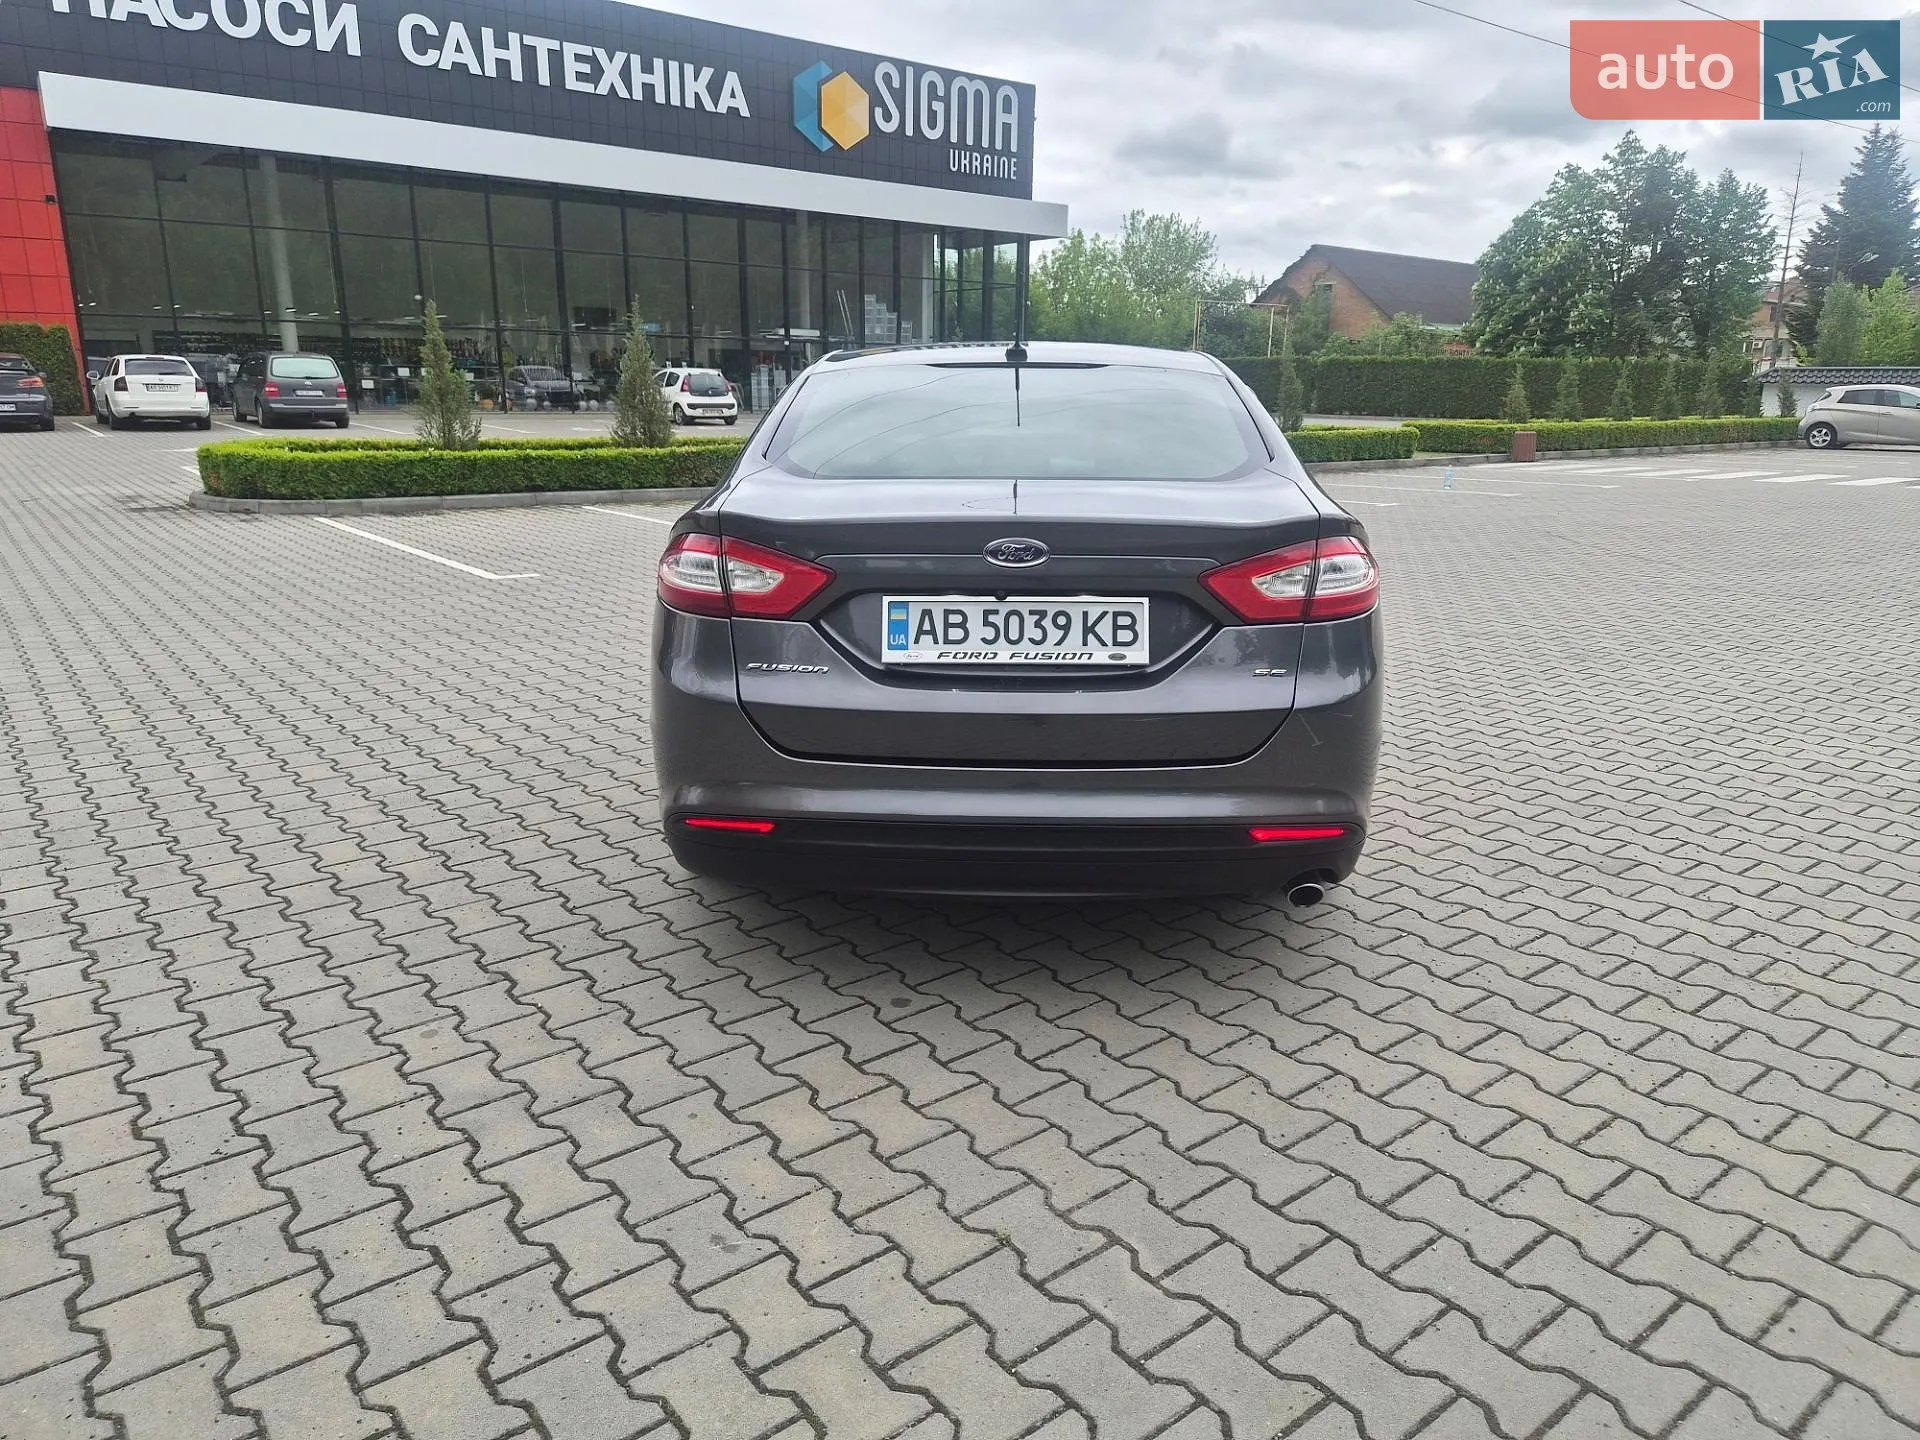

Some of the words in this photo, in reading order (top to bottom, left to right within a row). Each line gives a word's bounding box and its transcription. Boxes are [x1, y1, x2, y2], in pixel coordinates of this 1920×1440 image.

[53, 0, 361, 57] АСОСИ
[397, 13, 751, 118] САНТЕХНІКА
[874, 61, 1019, 153] SIGMA
[949, 149, 1017, 180] UKRAINE
[998, 543, 1035, 560] Ford
[890, 634, 907, 645] UA
[913, 608, 970, 645] AB
[980, 609, 1072, 646] 5039
[1081, 610, 1140, 647] KB
[937, 651, 999, 660] FORD
[1009, 652, 1094, 661] FUSION
